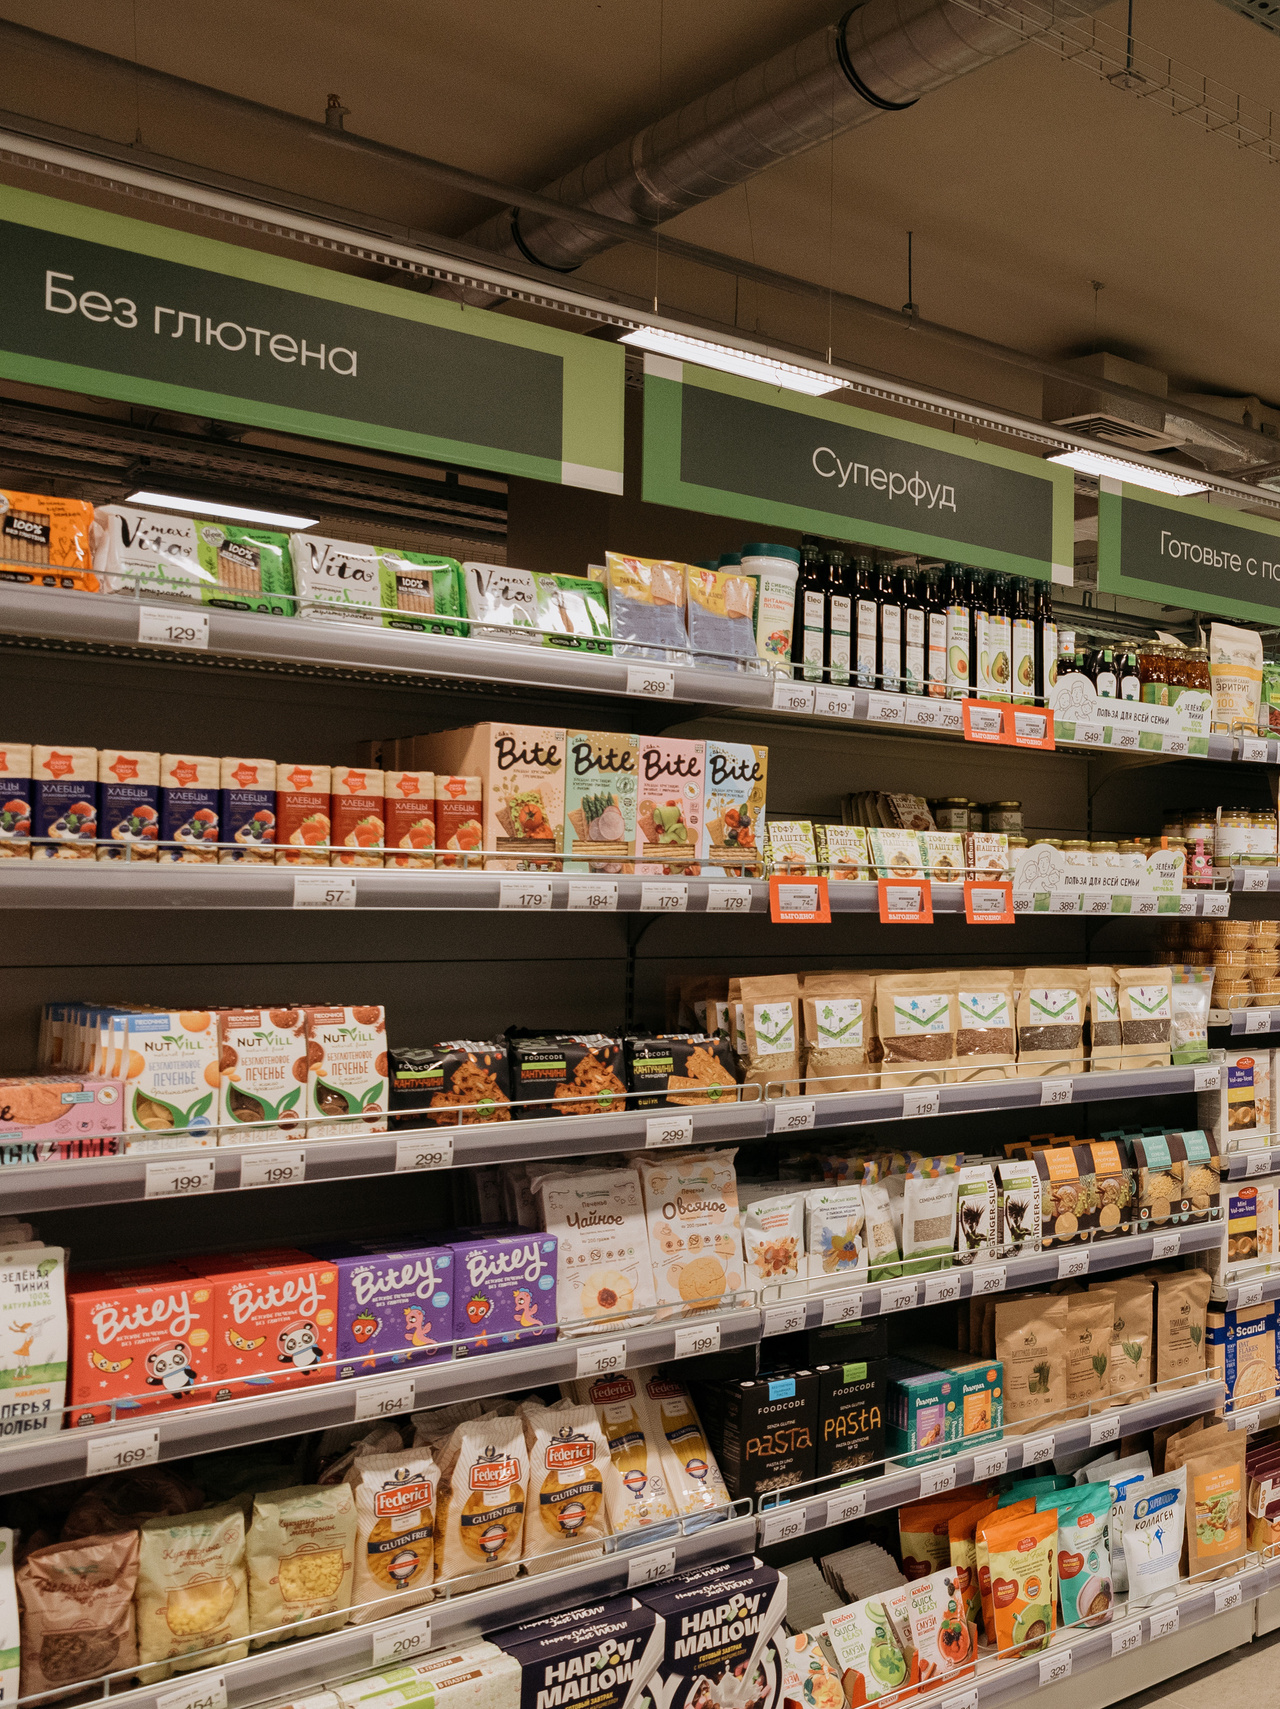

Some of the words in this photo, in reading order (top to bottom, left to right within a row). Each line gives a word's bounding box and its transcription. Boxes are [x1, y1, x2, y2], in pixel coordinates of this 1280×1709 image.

[44, 269, 138, 329] Без
[152, 305, 358, 377] глютена
[811, 446, 957, 513] Суперфуд
[150, 525, 192, 538] maxi
[1160, 530, 1242, 573] Готовьте
[1246, 557, 1258, 576] с
[305, 542, 375, 582] Vita
[165, 626, 196, 641] 129
[643, 680, 666, 692] 269
[1216, 683, 1249, 693] ЭРИТРИТ
[788, 698, 806, 708] 169
[828, 701, 847, 712] 619
[917, 712, 935, 722] 639
[943, 715, 959, 725] 759
[1097, 707, 1118, 719] ПОЛЬЗА
[1133, 711, 1149, 723] ВСЕЙ
[1150, 714, 1170, 726] СЕМЬИ
[494, 736, 562, 771] Bite
[572, 742, 635, 776] Bite
[642, 748, 701, 781] Bite
[709, 754, 763, 785] Bite
[42, 784, 85, 795] ХЛЕБЦЫ
[107, 787, 148, 798] ХЛЕБЦЫ
[230, 792, 267, 803] ХЛЕБЦЫ
[286, 796, 322, 806] ХЛЕБЦЫ
[772, 833, 809, 843] ПАШТЕТ
[928, 842, 960, 851] ПАШТЕТ
[976, 844, 1005, 852] ПАШТЕТ
[1065, 876, 1087, 886] ПОЛЬЗА
[1101, 876, 1119, 887] ВСЕЙ
[1120, 877, 1140, 887] СЕМЬИ
[325, 890, 344, 902] 57
[518, 893, 542, 906] 179
[586, 895, 608, 907] 184
[723, 897, 743, 908] 179
[780, 913, 815, 921] ВЫГОДНО!
[149, 1060, 200, 1071] БЕЗГЛЮТЕНОВОЕ
[241, 1056, 290, 1066] БЕЗГЛЮТЕНОВОЕ
[245, 1066, 285, 1081] ПЕЧЕНЬЕ
[331, 1061, 368, 1076] ПЕЧЕНЬЕ
[153, 1071, 196, 1087] ПЕЧЕНЬЕ
[915, 1103, 932, 1113] 119
[787, 1115, 807, 1127] 259
[662, 1130, 684, 1141] 299
[415, 1152, 442, 1166] 299
[264, 1167, 293, 1181] 199
[170, 1175, 202, 1191] 199
[662, 1197, 727, 1221] Овсяное
[566, 1210, 625, 1230] Чайное
[466, 1241, 548, 1288] Bitey
[14, 1281, 50, 1294] ЛИНИЯ
[351, 1257, 442, 1306] Bitey
[983, 1279, 1000, 1290] 209
[229, 1272, 327, 1325] Bitey
[938, 1288, 954, 1299] 109
[894, 1296, 911, 1307] 179
[92, 1290, 200, 1345] Bitey
[842, 1307, 855, 1318] 35
[784, 1318, 798, 1329] 35
[1236, 1320, 1266, 1337] Scandi
[691, 1337, 713, 1350] 199
[595, 1356, 617, 1370] 159
[593, 1381, 632, 1399] Federici
[833, 1381, 875, 1397] FOODCODE
[2, 1399, 51, 1419] ПЕРЬЯ
[377, 1398, 403, 1413] 164
[758, 1399, 805, 1415] FOODCODE
[1099, 1428, 1115, 1440] 339
[113, 1448, 146, 1465] 169
[549, 1443, 591, 1462] Federici
[1033, 1448, 1049, 1460] 299
[473, 1463, 516, 1482] Federici
[986, 1462, 1002, 1474] 119
[933, 1478, 949, 1491] 119
[378, 1485, 429, 1509] Federici
[551, 1488, 575, 1502] GLUTEN
[576, 1483, 594, 1496] FREE
[472, 1511, 499, 1527] GLUTEN
[500, 1505, 517, 1519] FREE
[841, 1505, 859, 1519] 189
[1134, 1510, 1174, 1531] КОЛЛАГЕН
[779, 1524, 798, 1537] 159
[379, 1536, 406, 1552] GLUTEN
[407, 1528, 428, 1543] FREE
[645, 1564, 666, 1579] 112
[911, 1596, 933, 1610] QUICK
[682, 1593, 760, 1636] HAPPY
[916, 1617, 937, 1631] СМУЗИ
[1159, 1620, 1174, 1634] 719
[674, 1611, 770, 1660] MALLOW
[1121, 1635, 1137, 1649] 319
[393, 1635, 420, 1654] 209
[545, 1639, 634, 1686] HAPPY
[1050, 1665, 1066, 1679] 329
[445, 1673, 473, 1686] ГЛАЗУРИ
[537, 1659, 641, 1709] MALLOW
